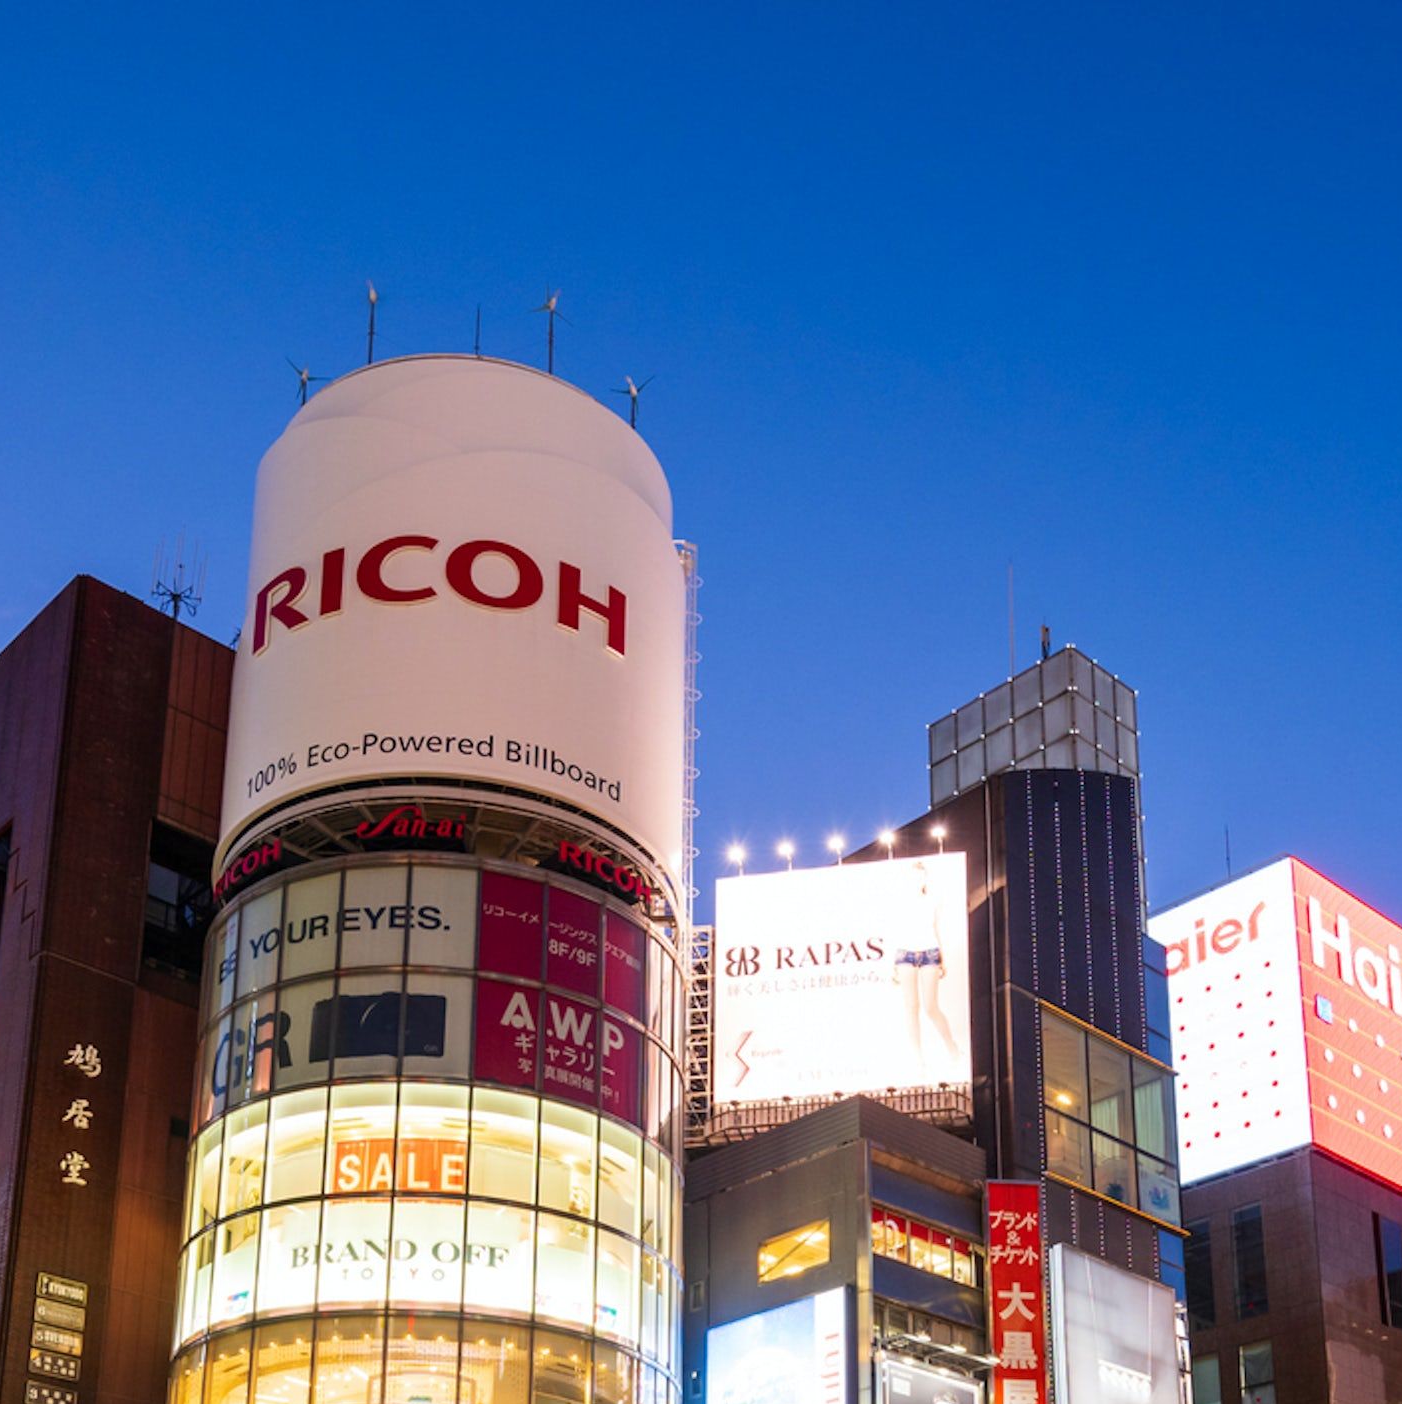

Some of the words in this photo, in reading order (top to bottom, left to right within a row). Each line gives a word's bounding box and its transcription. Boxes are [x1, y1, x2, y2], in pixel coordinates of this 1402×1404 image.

[252, 534, 628, 658] RICOH
[246, 753, 298, 800] 100%
[306, 731, 495, 769] Eco-Powered
[505, 740, 623, 804] Billboard
[212, 839, 283, 902] RICOH
[558, 840, 653, 904] RICOH
[249, 913, 330, 960] YOUR
[338, 904, 451, 934] EYES.
[548, 938, 598, 969] 8F/9F
[775, 937, 885, 970] RAPAS
[513, 1032, 617, 1077] ギャラリー
[337, 1154, 465, 1191] SALE
[291, 1238, 417, 1269] BRAND
[431, 1240, 510, 1268] OFF
[342, 1268, 445, 1281] TOYO
